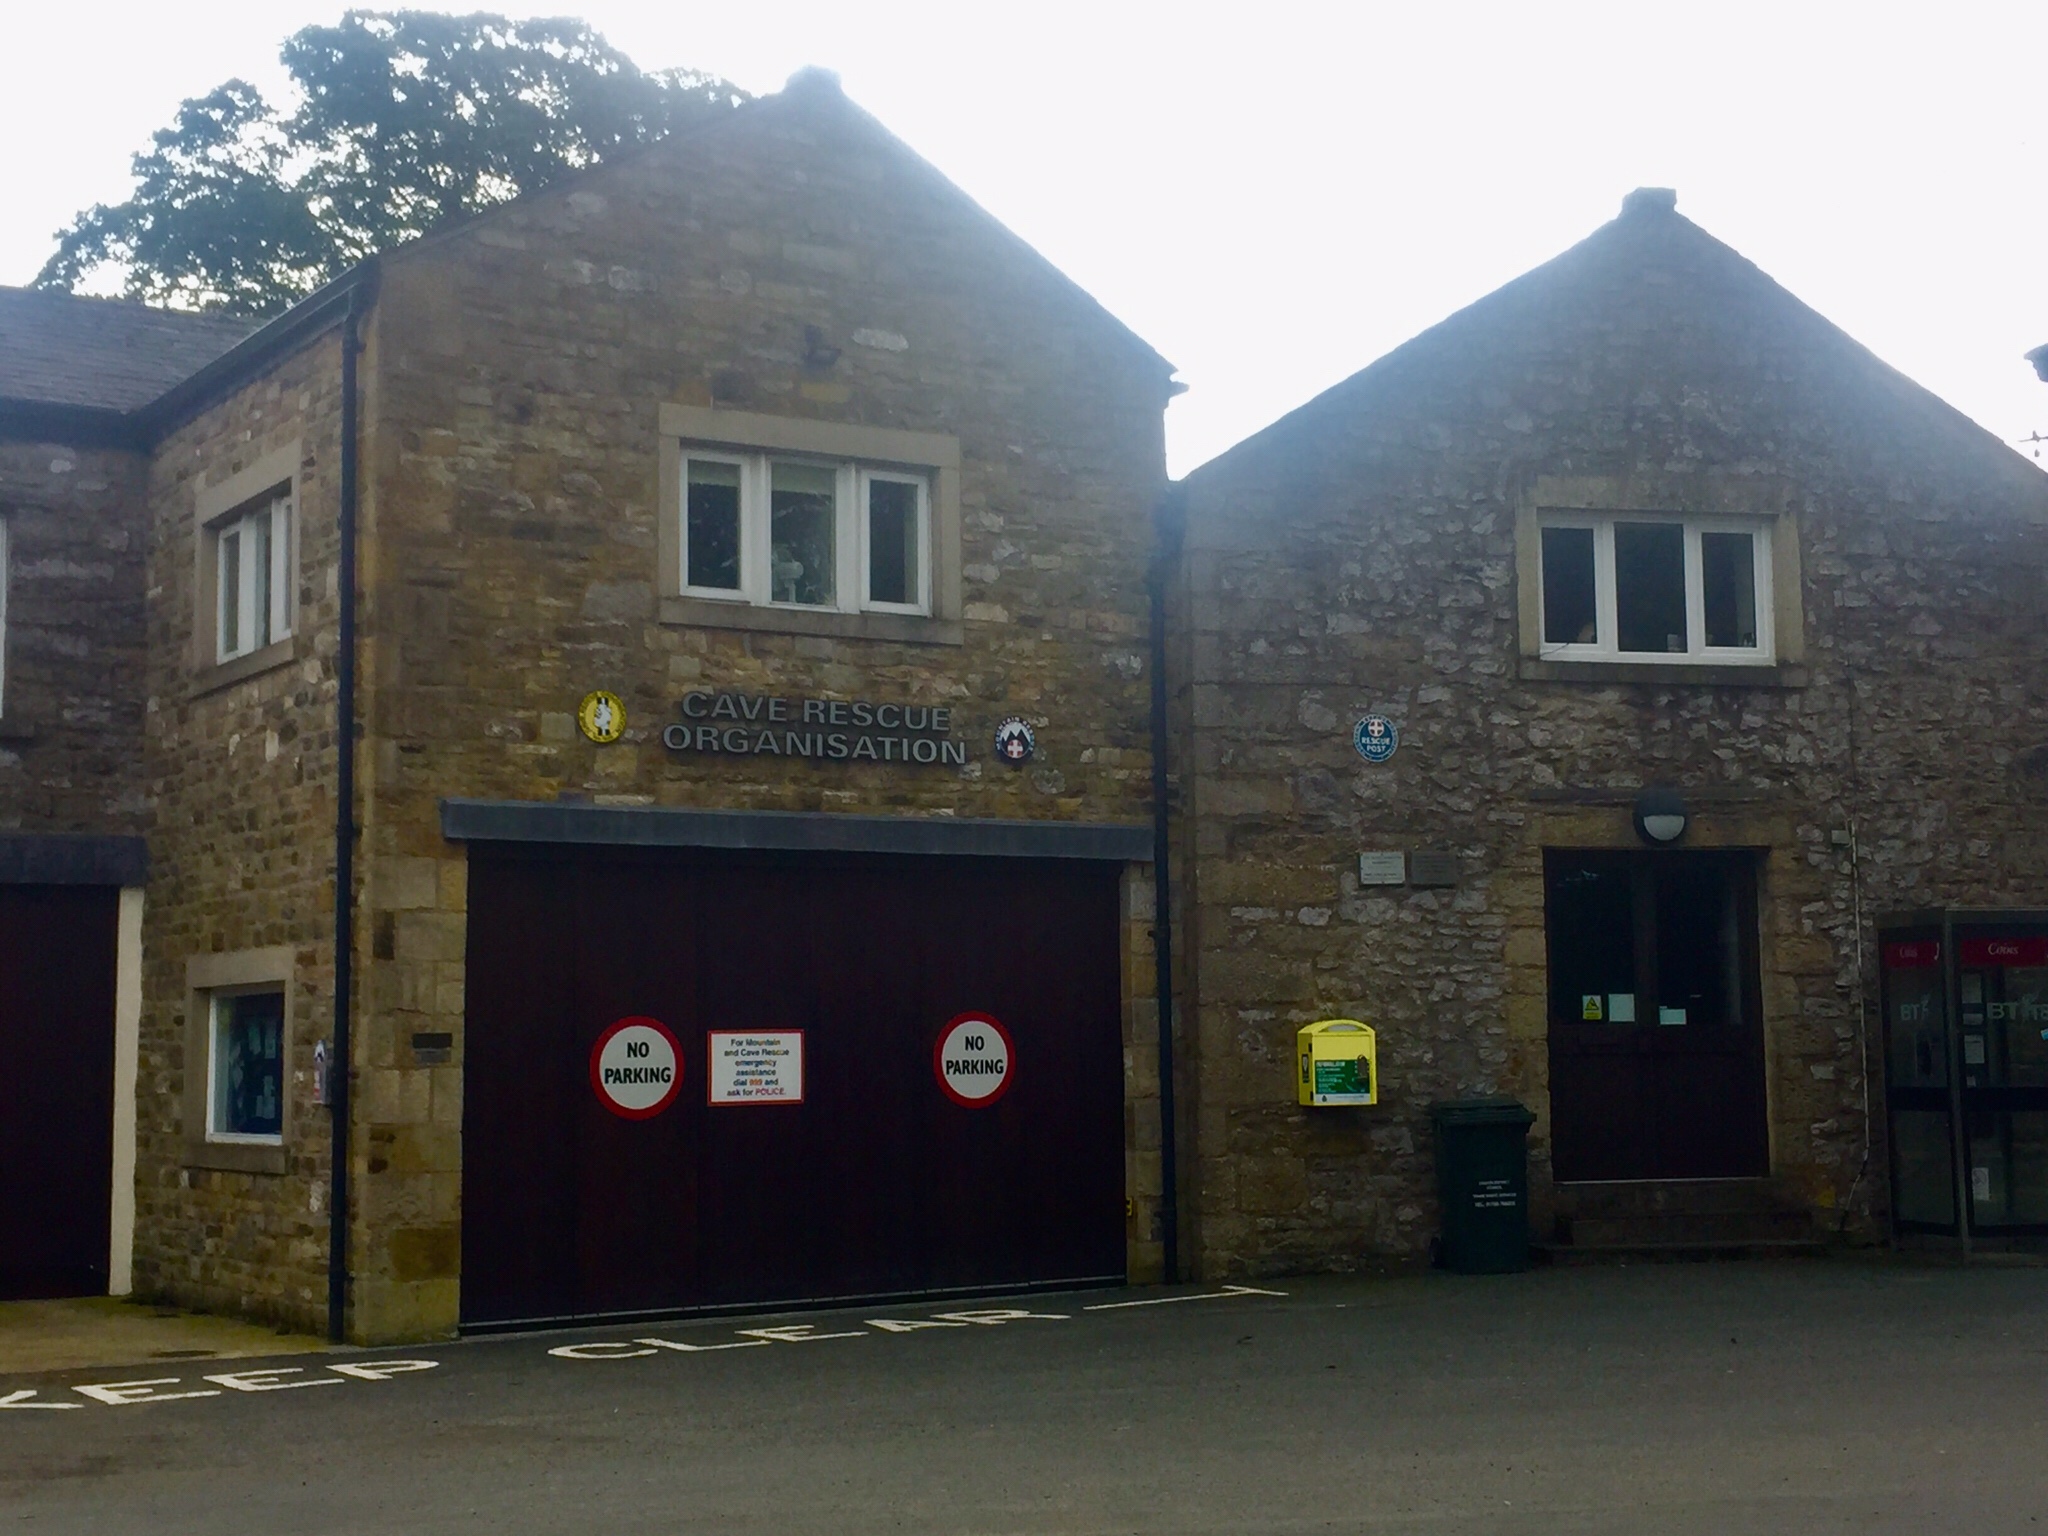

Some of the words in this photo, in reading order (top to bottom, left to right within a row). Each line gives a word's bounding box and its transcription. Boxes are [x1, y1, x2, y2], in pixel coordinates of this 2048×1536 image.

[682, 690, 788, 722] CAVE
[803, 700, 951, 731] RESCUE
[663, 723, 966, 764] ORGANISATION
[1361, 736, 1391, 746] RESCUE
[1366, 745, 1387, 753] POST
[746, 1038, 781, 1046] Mountain
[965, 1036, 984, 1051] NO
[627, 1042, 649, 1058] NO
[724, 1049, 739, 1057] and
[740, 1048, 760, 1056] Cave
[761, 1048, 790, 1056] Rescue
[735, 1060, 777, 1068] emergency
[945, 1059, 1004, 1075] PARKING
[604, 1066, 672, 1084] PARKING
[733, 1078, 747, 1086] dial
[764, 1078, 779, 1086] and
[727, 1089, 741, 1097] ask
[742, 1088, 754, 1096] for
[548, 1308, 1071, 1360] CLEAR
